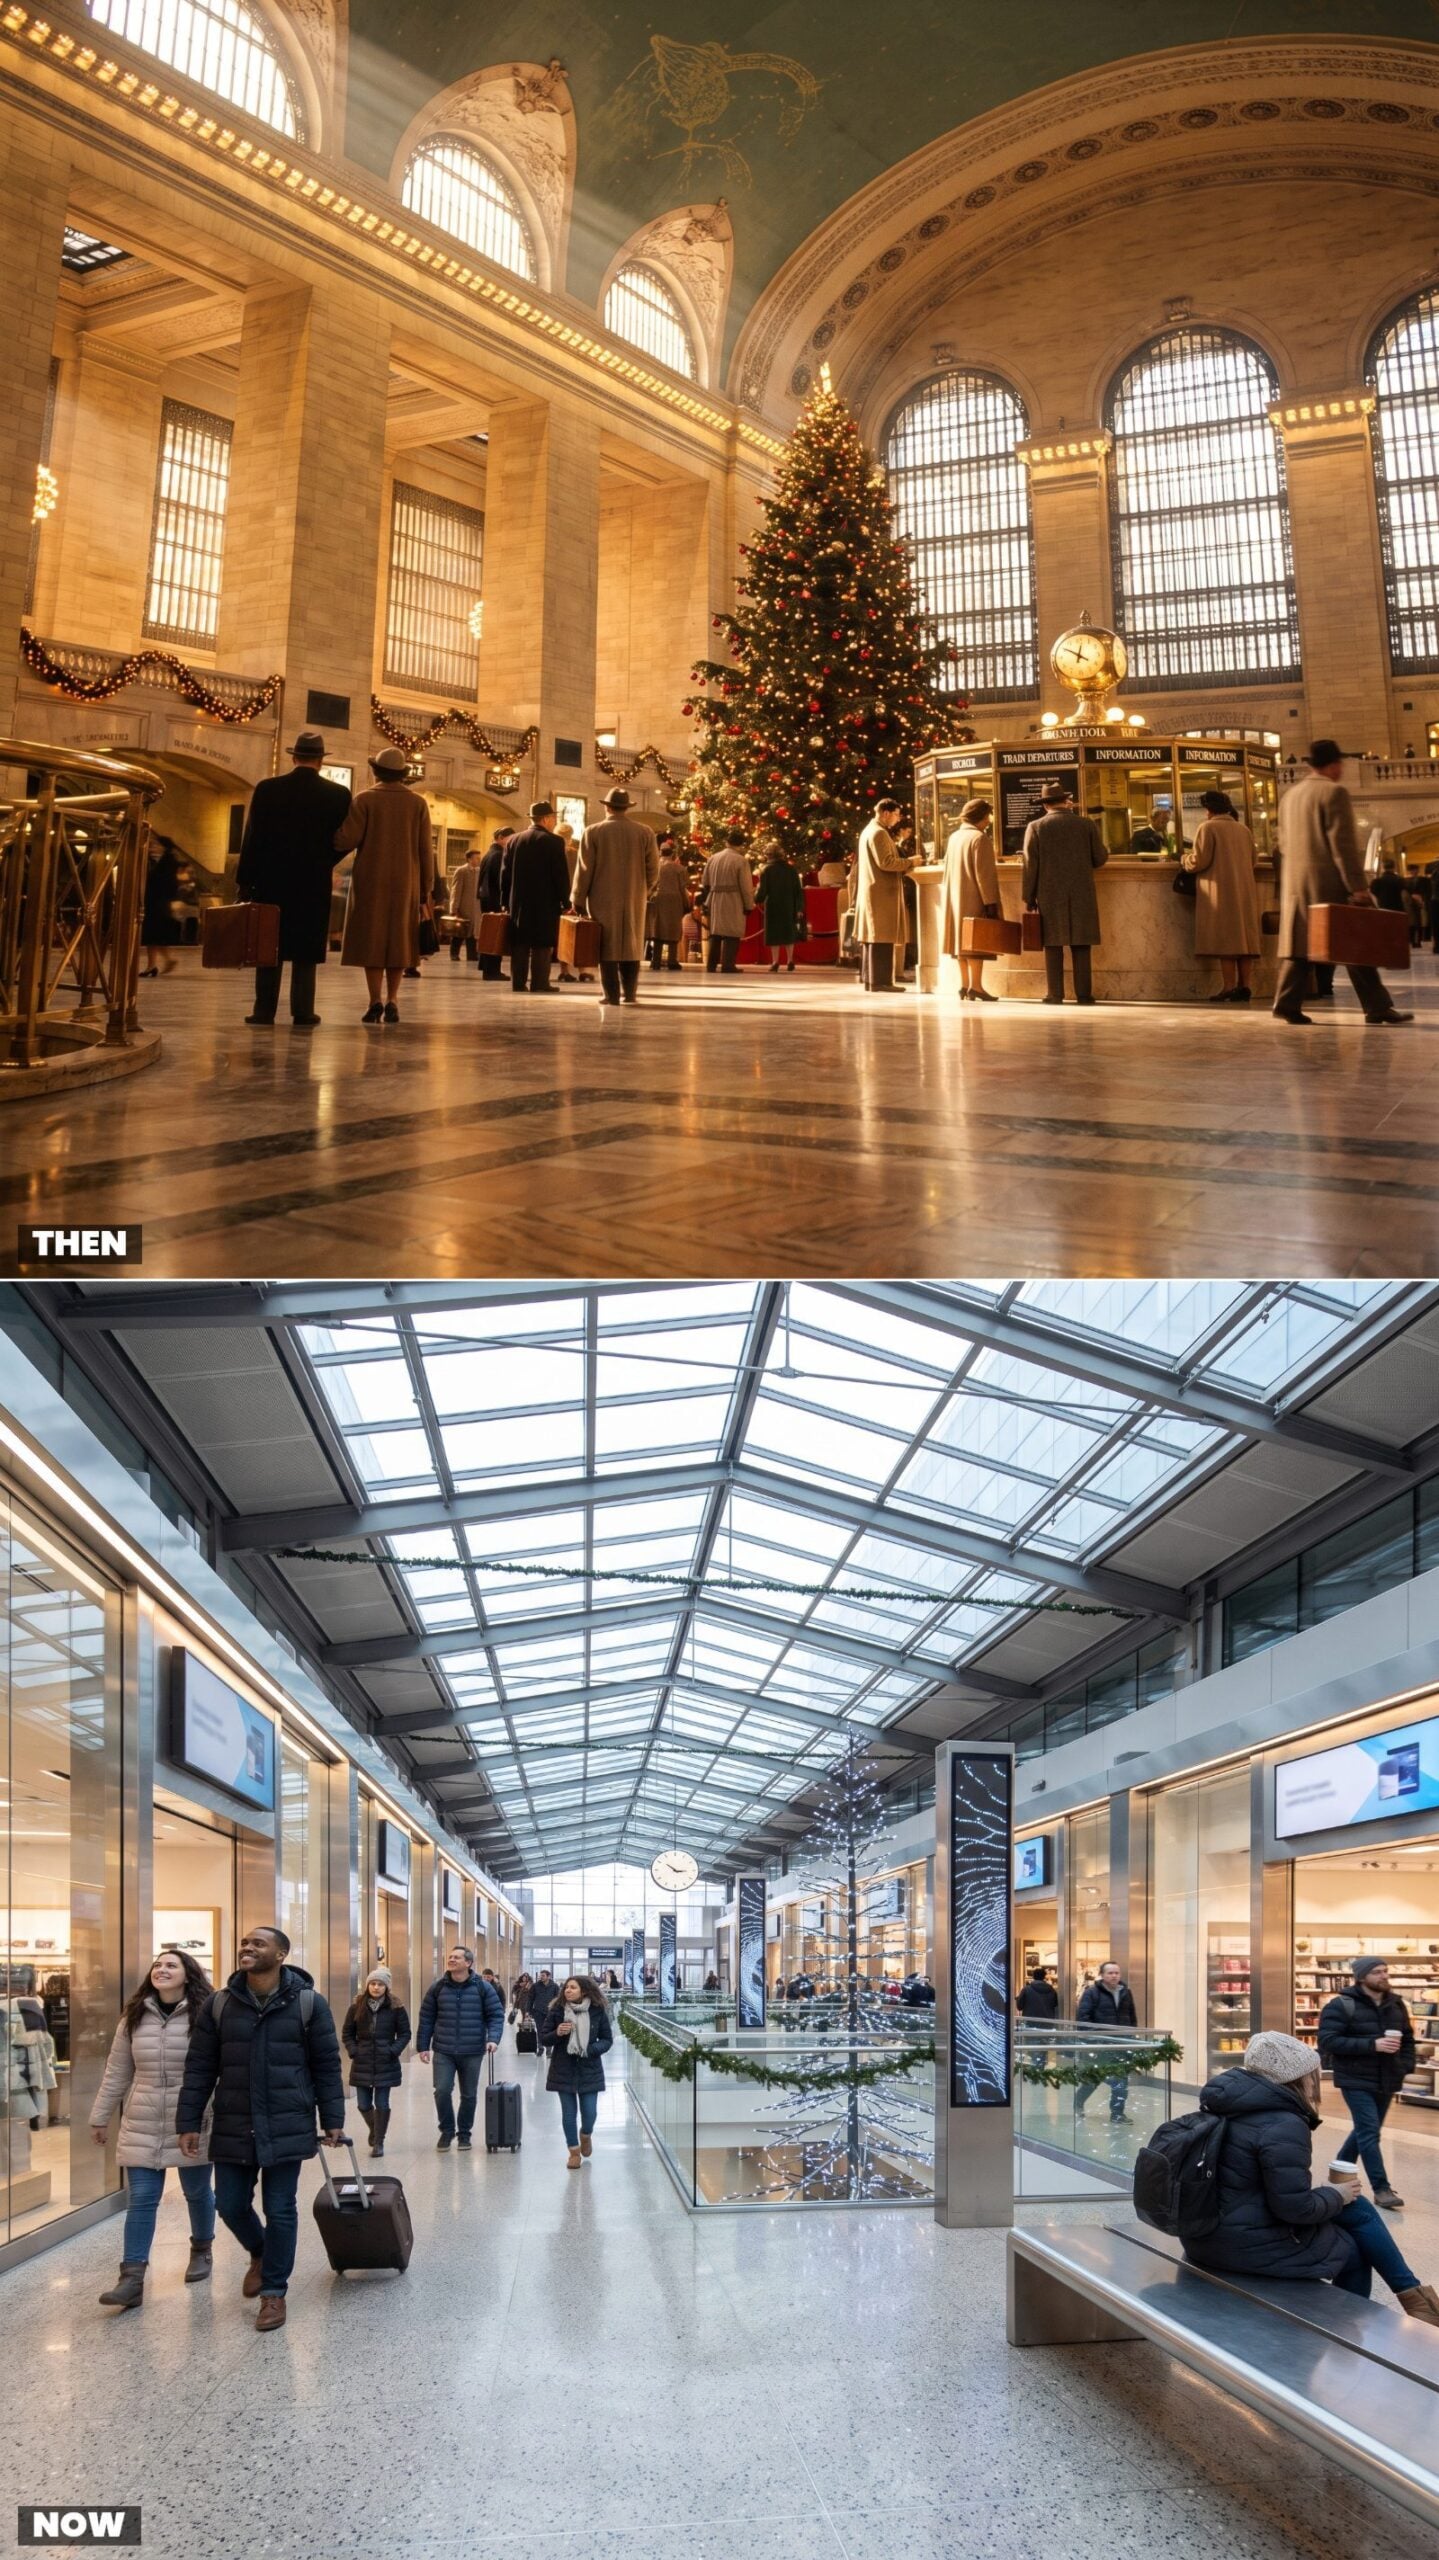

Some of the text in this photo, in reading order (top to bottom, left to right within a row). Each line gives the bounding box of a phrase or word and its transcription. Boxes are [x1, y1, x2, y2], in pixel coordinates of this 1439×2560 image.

[1003, 751, 1075, 764] TRAIN DEPARTURES
[1096, 749, 1161, 760] INFORMATION
[1185, 750, 1237, 762] INFORMATION
